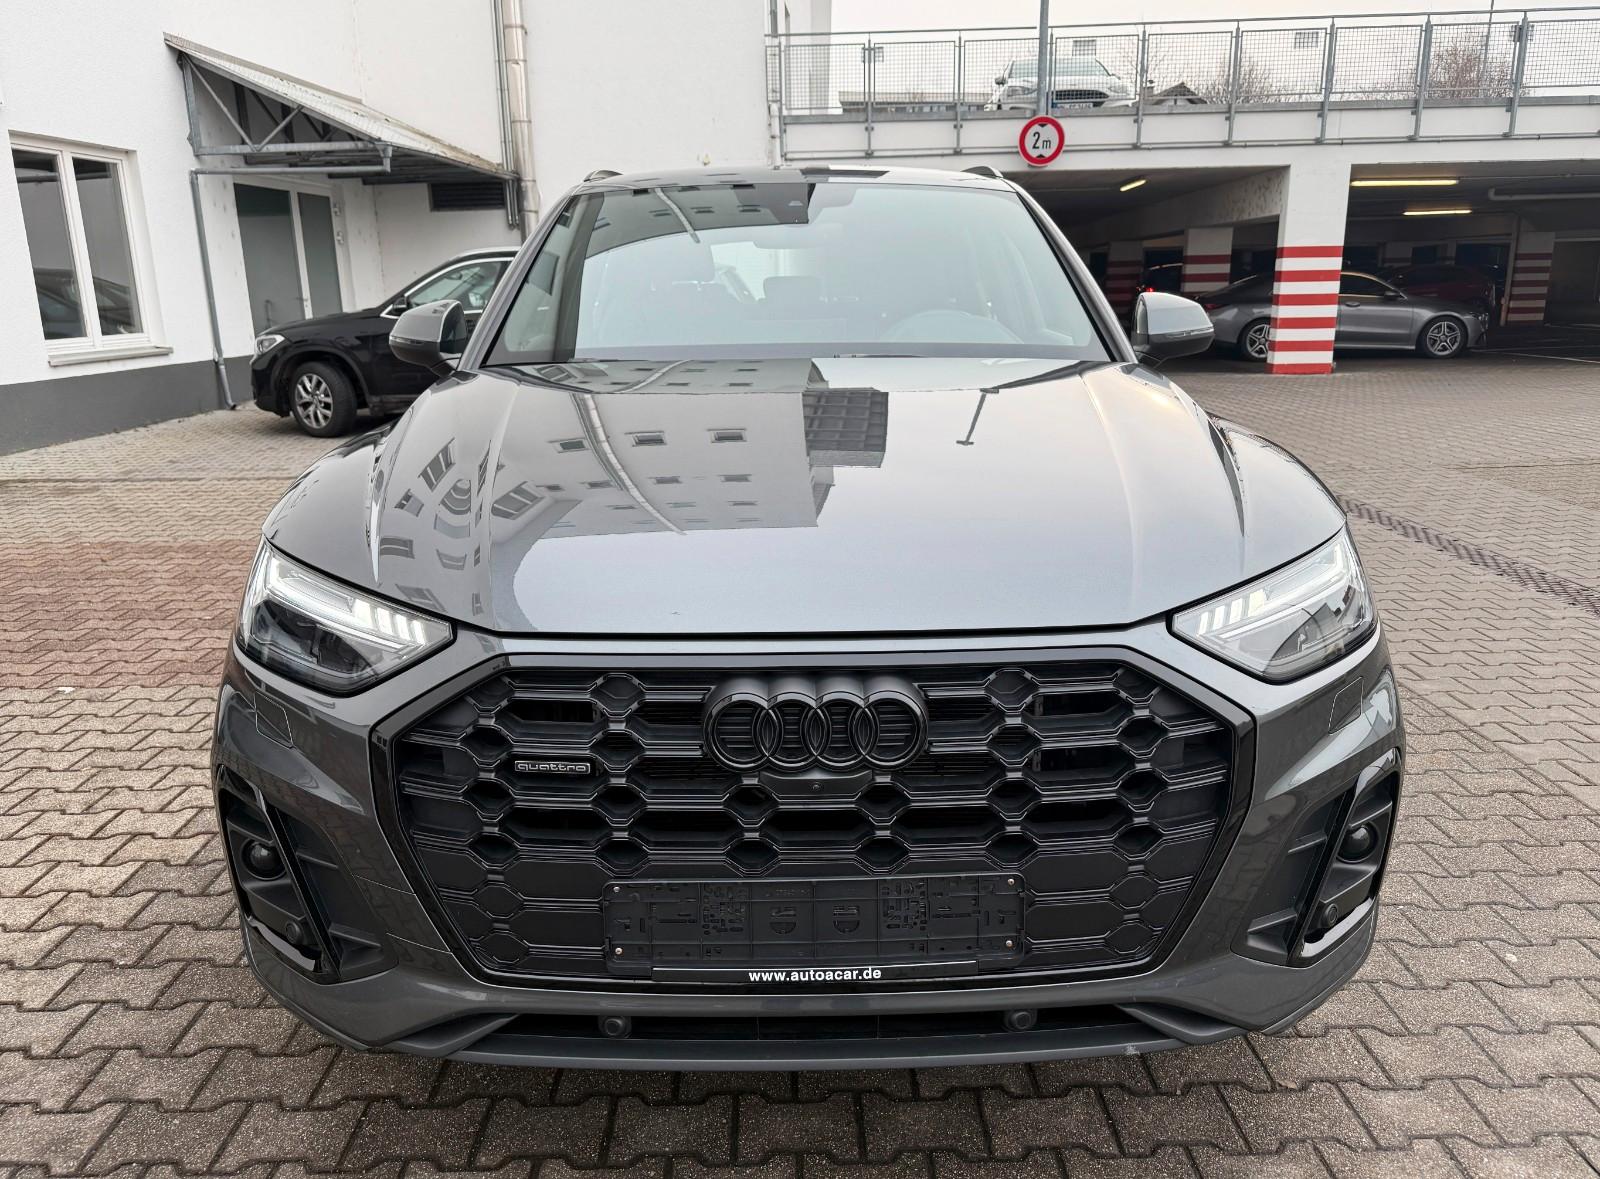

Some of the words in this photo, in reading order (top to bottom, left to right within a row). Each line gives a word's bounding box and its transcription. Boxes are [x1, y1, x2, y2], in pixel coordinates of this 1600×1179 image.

[1032, 131, 1041, 150] 2
[1042, 139, 1052, 149] m
[517, 763, 587, 771] quattro
[748, 966, 882, 982] www.autoacar.de
